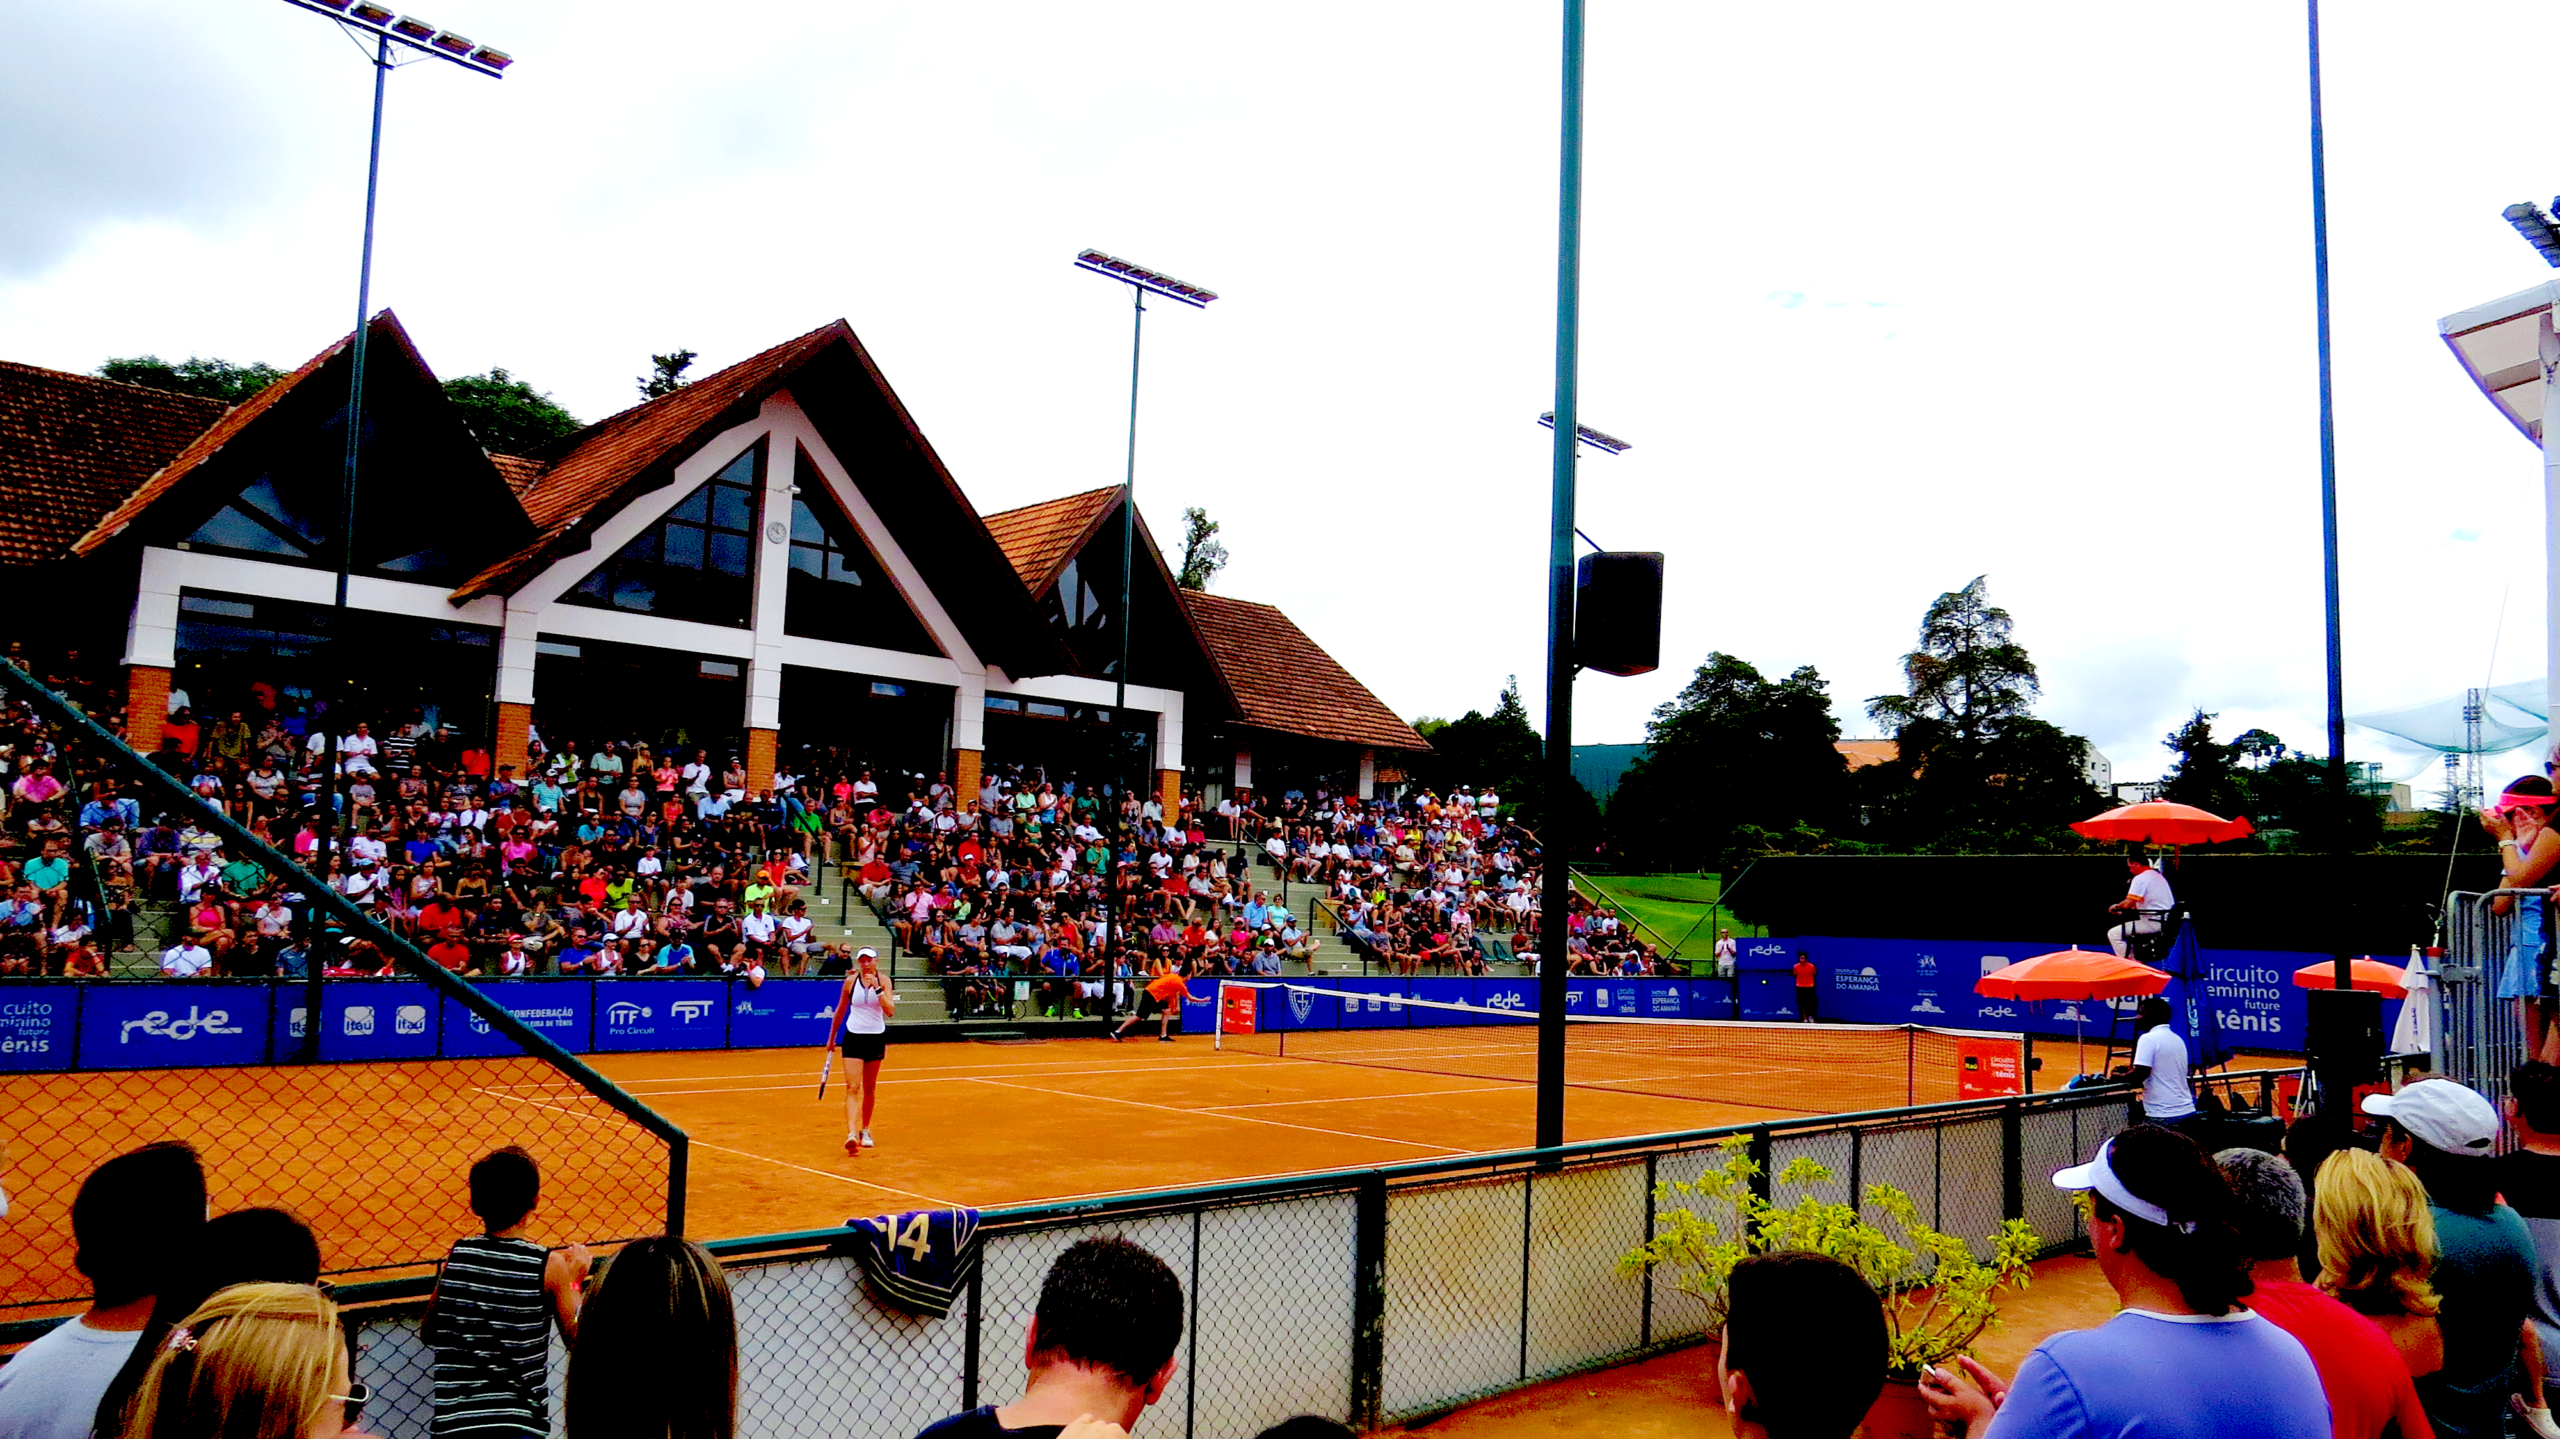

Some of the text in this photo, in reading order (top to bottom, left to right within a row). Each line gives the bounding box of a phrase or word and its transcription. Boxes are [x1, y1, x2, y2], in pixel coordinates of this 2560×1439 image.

[1749, 944, 1786, 957] rede
[1835, 975, 1879, 985] ESPERANÇA
[2203, 963, 2279, 984] ircuito
[1835, 982, 1847, 990] DO
[2207, 983, 2280, 1000] eminino
[3, 1000, 52, 1015] cuito
[1486, 990, 1525, 1010] rede
[2244, 999, 2281, 1010] future
[610, 1010, 639, 1025] ITF
[1979, 1005, 2017, 1018] rede
[121, 1005, 242, 1043] rede
[346, 1019, 373, 1031] Itaú
[2216, 1009, 2281, 1033] tênis
[610, 1027, 625, 1035] Pro
[1, 1035, 50, 1053] ênis
